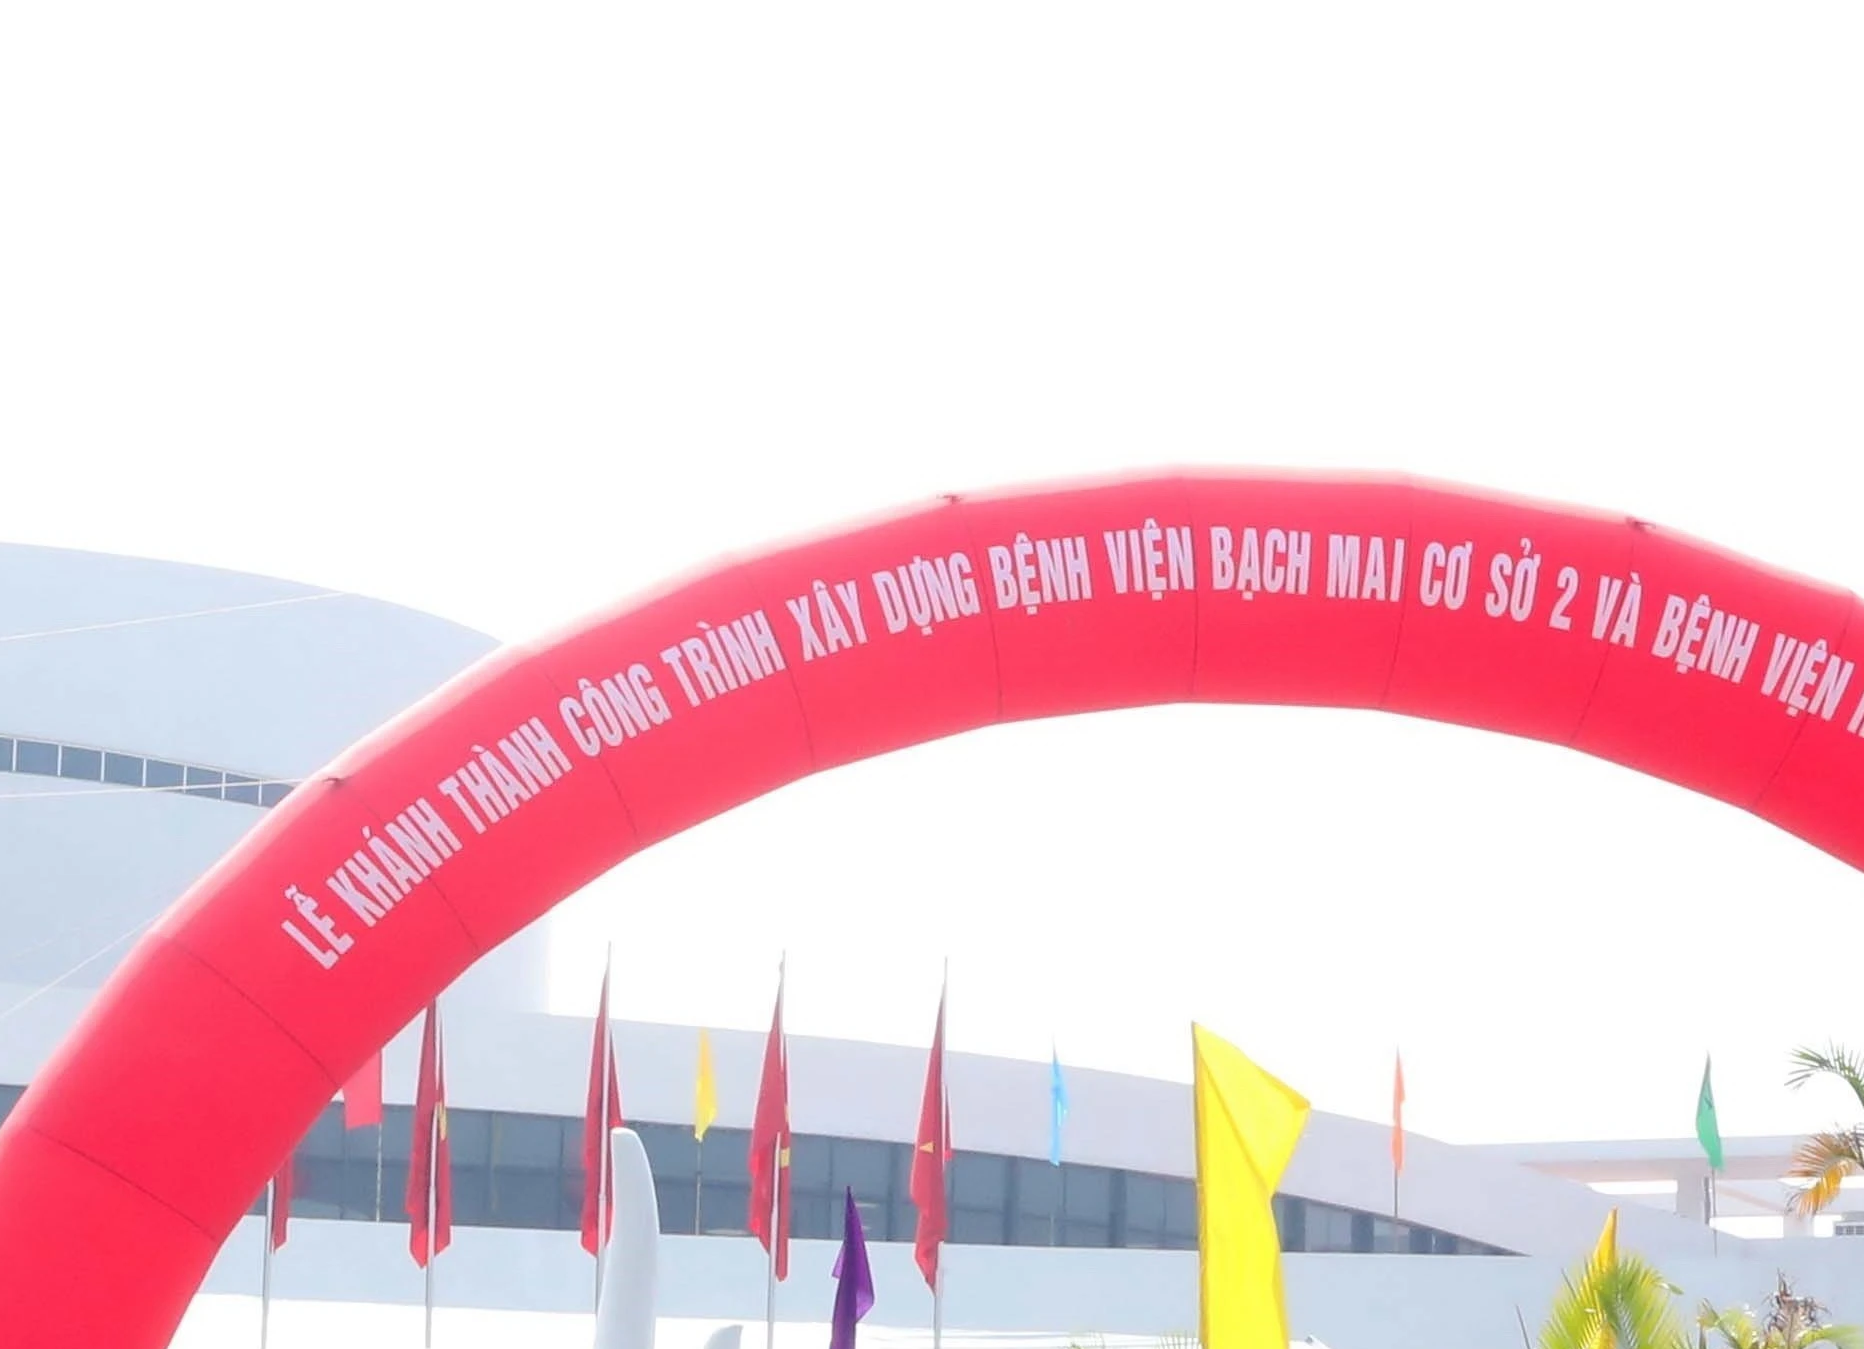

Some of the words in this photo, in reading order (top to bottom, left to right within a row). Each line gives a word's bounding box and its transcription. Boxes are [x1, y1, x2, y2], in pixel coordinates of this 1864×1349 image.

[281, 884, 354, 970] LỄ
[326, 827, 463, 927] KHÁNH
[439, 717, 574, 834] THÀNH
[559, 663, 672, 758] CÔNG
[660, 609, 786, 708] TRÌNH
[786, 581, 867, 661] XÂY
[872, 552, 980, 635] DỰNG
[988, 533, 1092, 615] BỆNH
[1103, 517, 1194, 601] VIỆN
[1210, 526, 1311, 600] BẠCH
[1326, 534, 1405, 602] MAI
[1420, 541, 1473, 610] CƠ
[1485, 537, 1542, 622] SỞ
[1549, 566, 1579, 630] 2
[1592, 572, 1642, 647] VÀ
[1651, 593, 1760, 683] BỆNH
[1761, 633, 1855, 721] VIỆN
